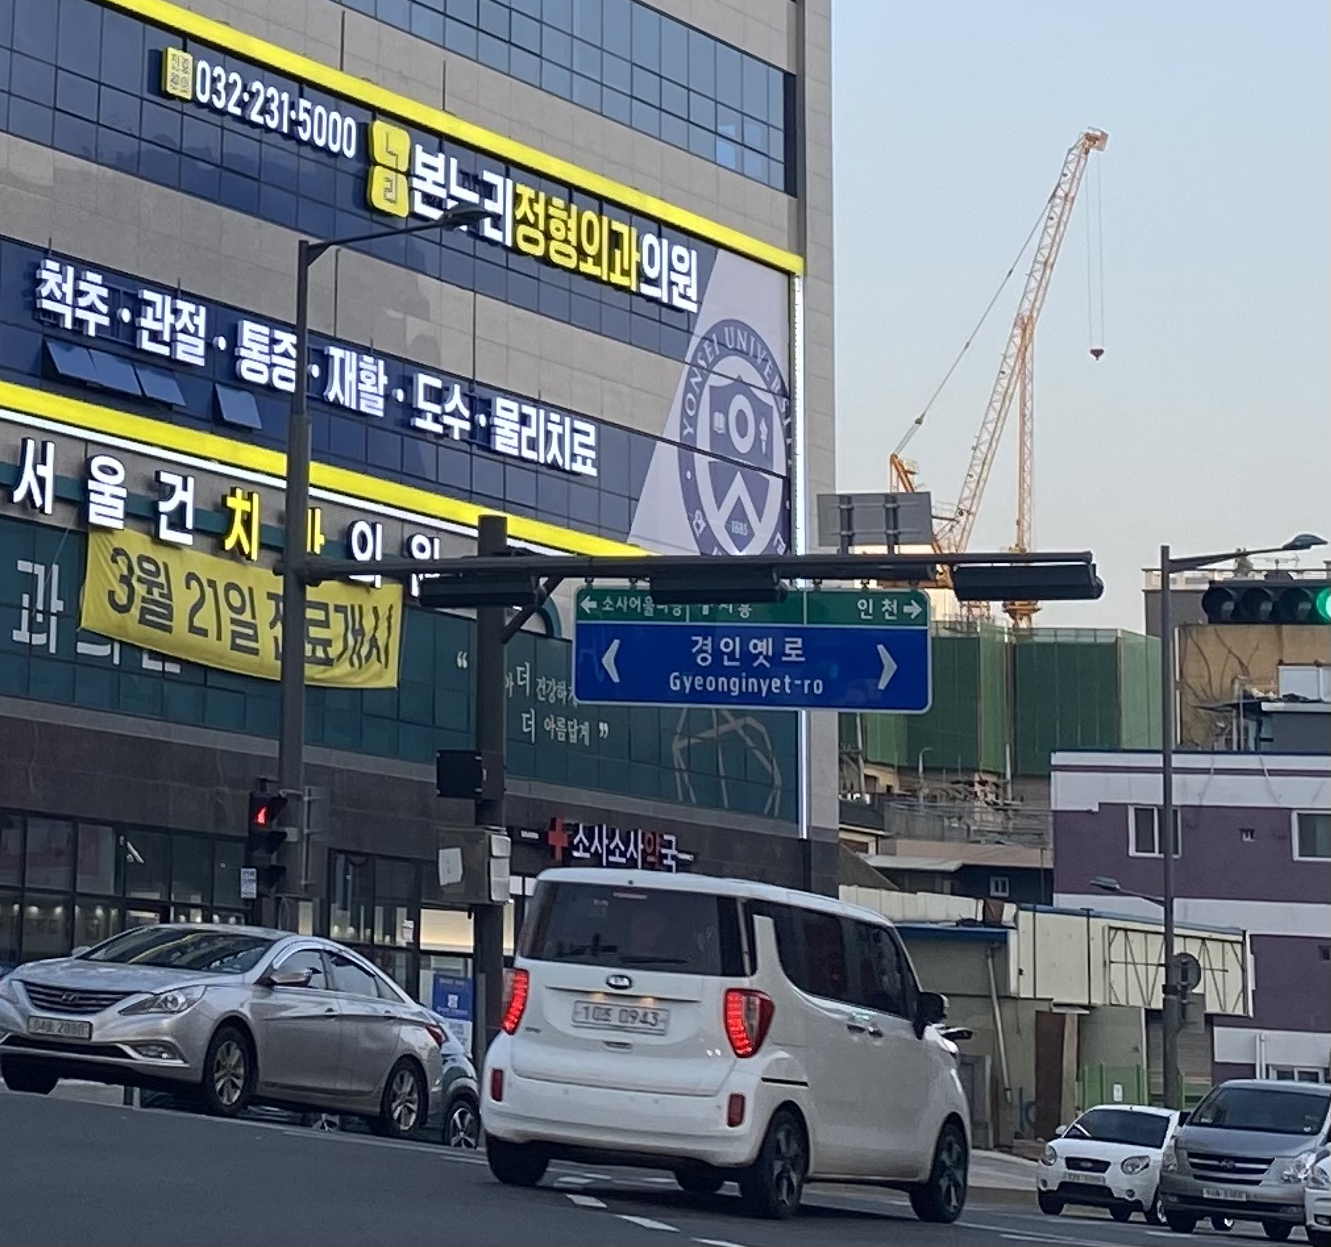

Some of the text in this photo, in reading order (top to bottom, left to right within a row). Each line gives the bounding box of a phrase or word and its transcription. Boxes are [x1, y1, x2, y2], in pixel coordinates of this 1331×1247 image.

[682, 331, 721, 438] YONSEI
[490, 396, 598, 477] 물리치료
[108, 546, 174, 633] 3월
[185, 571, 260, 656] 21일
[856, 598, 899, 621] 인천
[690, 635, 807, 668] 경인옛로
[669, 671, 824, 697] Gyeonginyet-ro
